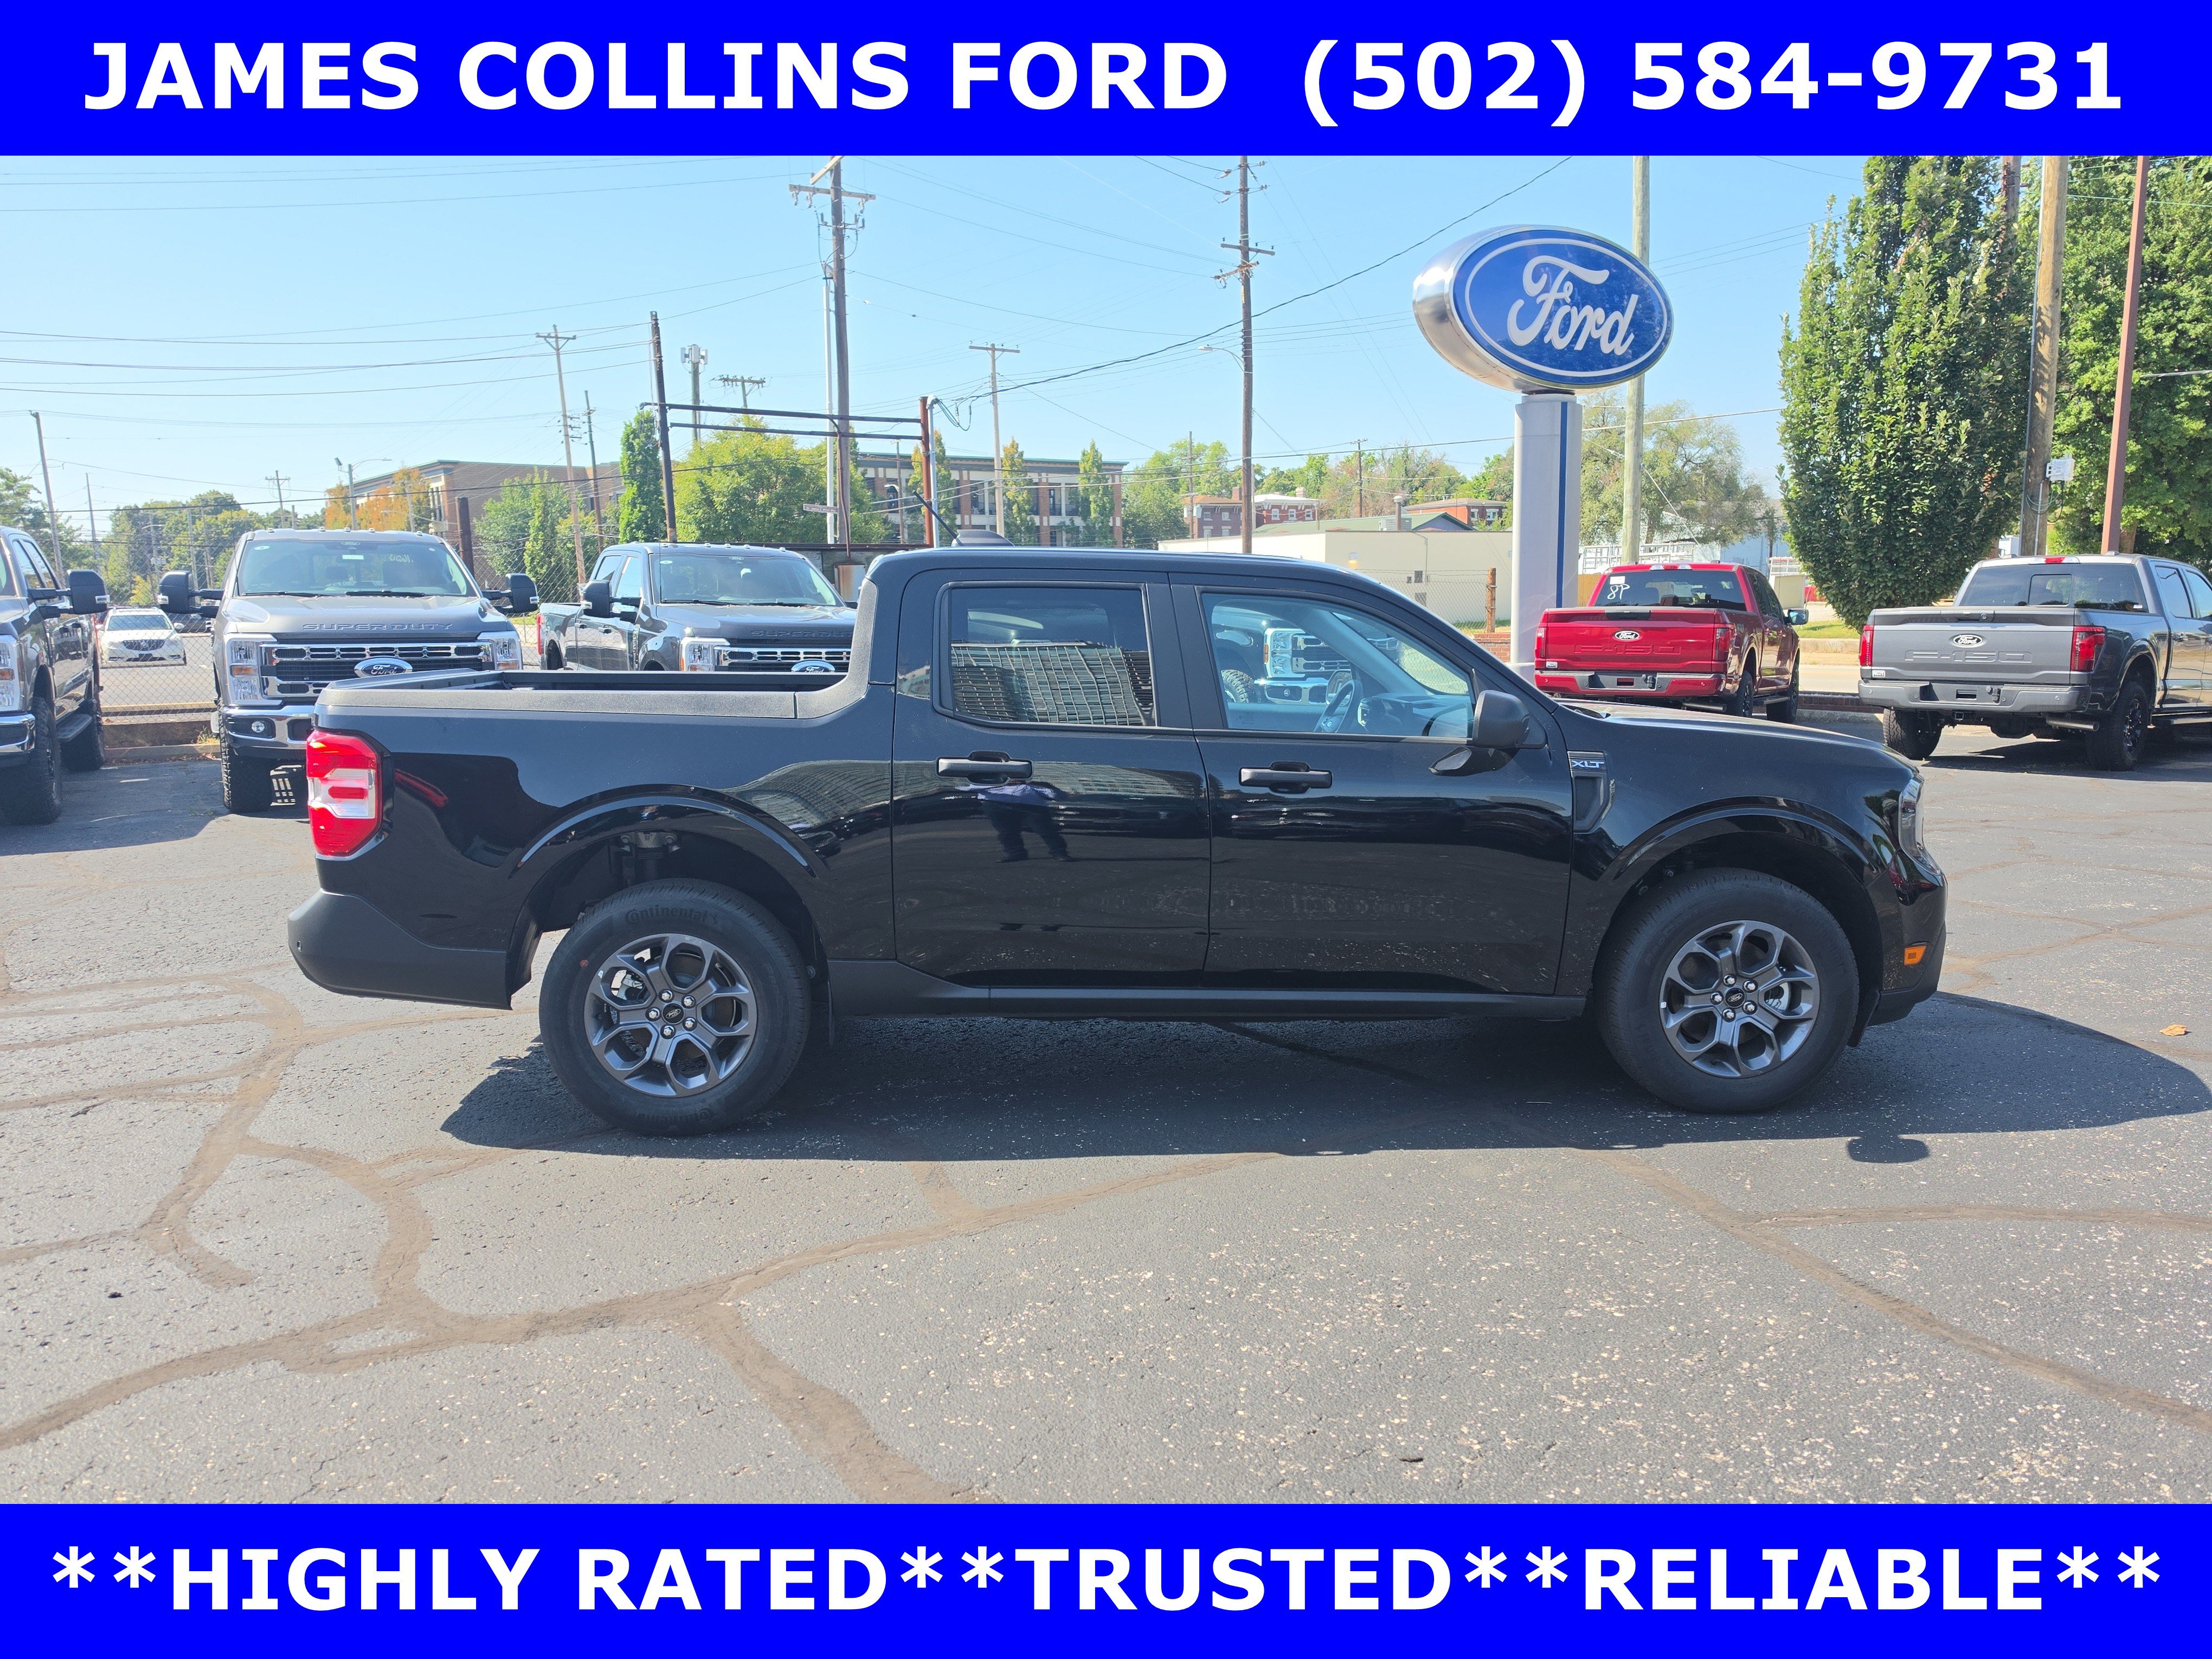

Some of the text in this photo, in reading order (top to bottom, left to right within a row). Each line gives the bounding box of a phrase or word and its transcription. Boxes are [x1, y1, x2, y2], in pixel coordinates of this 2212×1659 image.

[1507, 255, 1639, 356] Ford
[1574, 644, 1681, 655] F-150
[1904, 650, 2032, 664] F-150
[371, 664, 397, 675] Ford
[1571, 760, 1604, 768] XLT
[625, 904, 709, 923] Continental
